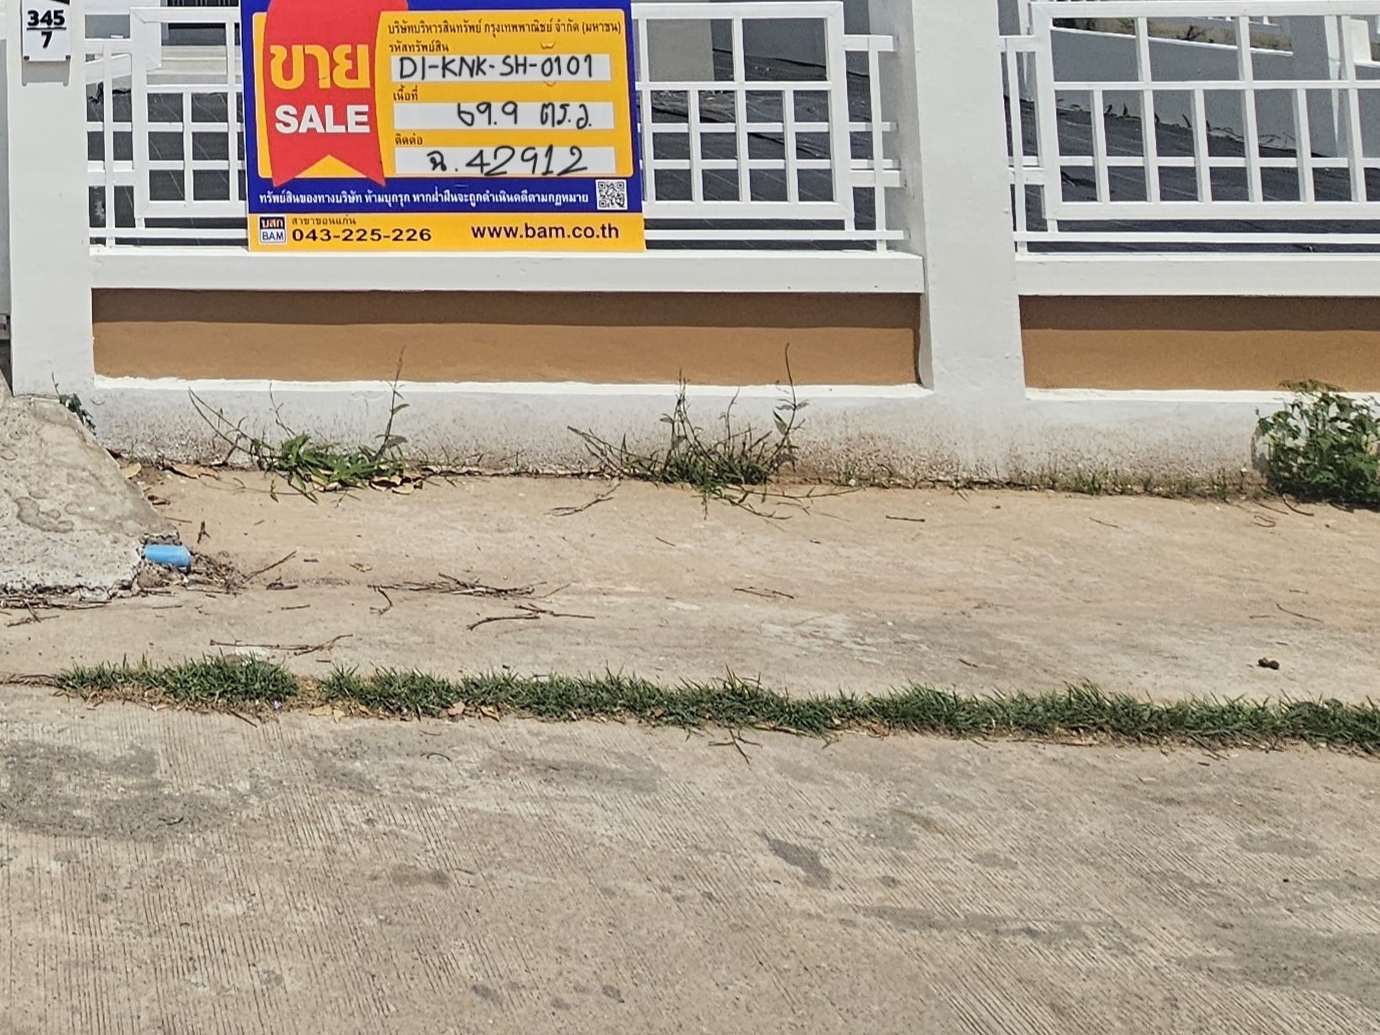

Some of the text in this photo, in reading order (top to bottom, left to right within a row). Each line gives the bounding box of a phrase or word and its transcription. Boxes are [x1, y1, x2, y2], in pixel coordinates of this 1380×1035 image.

[27, 10, 65, 27] 345
[388, 18, 621, 38] บริษัทบริหารสินทรัพย์ กรุงเทพพาณิชย์ จำกัด (มหาชน)
[41, 31, 52, 48] 7
[388, 40, 449, 53] รหัสทรัพย์สิน
[269, 43, 371, 90] ขาย
[393, 84, 419, 102] เนื้อที่
[275, 105, 370, 133] SALE
[394, 133, 424, 146] ติดต่อ
[365, 190, 410, 207] ห้ามบุกรุก
[291, 214, 356, 225] สาขาขอนแก่น
[262, 230, 284, 241] BAM
[292, 228, 432, 242] 043-225-226
[471, 223, 619, 240] www.bam.co.th
